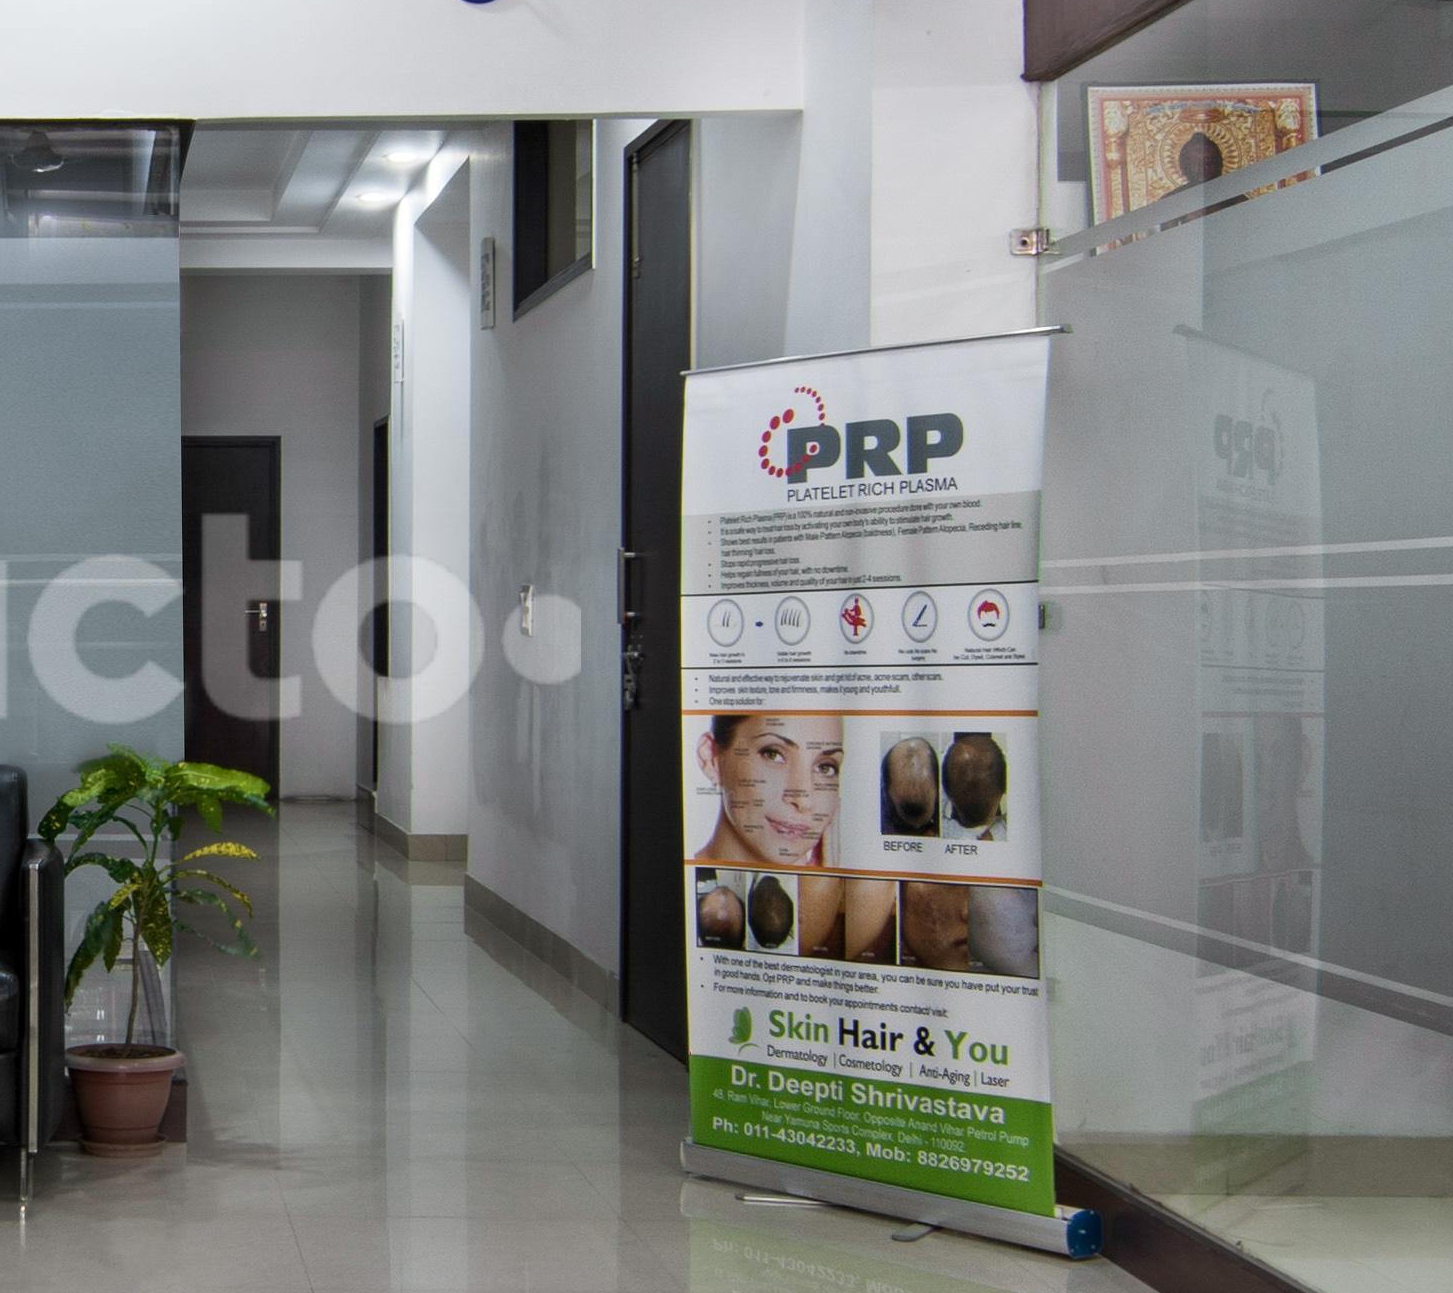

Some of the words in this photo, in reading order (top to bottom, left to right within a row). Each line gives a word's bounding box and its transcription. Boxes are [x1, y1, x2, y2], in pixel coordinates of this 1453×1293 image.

[786, 412, 964, 485] PRP
[788, 484, 855, 502] PLATELET
[858, 482, 895, 497] RICH
[900, 477, 958, 494] PLASMA
[969, 523, 998, 533] Receding
[883, 841, 924, 853] BEFORE
[944, 844, 978, 856] AFTER
[713, 955, 730, 965] With
[730, 958, 743, 967] one
[745, 957, 753, 968] of
[753, 958, 763, 970] the
[764, 960, 780, 971] best
[781, 962, 834, 977] dermatologist
[835, 966, 840, 976] in
[842, 968, 856, 979] your
[881, 973, 897, 984] you
[899, 974, 914, 983] can
[916, 976, 926, 985] be
[927, 978, 944, 987] sure
[945, 980, 960, 989] you
[962, 980, 984, 991] have
[985, 982, 1000, 994] put
[1001, 985, 1020, 996] your
[1022, 987, 1039, 996] trust
[714, 968, 721, 976] in
[722, 970, 738, 979] good
[763, 973, 776, 984] Opt
[777, 974, 795, 983] PRP
[796, 977, 810, 987] and
[812, 979, 832, 989] make
[833, 981, 854, 994] things
[713, 982, 726, 991] For
[727, 985, 744, 995] more
[745, 986, 784, 1000] information
[785, 992, 800, 1002] and
[801, 993, 808, 1002] to
[809, 994, 828, 1004] book
[829, 997, 844, 1006] your
[845, 998, 898, 1013] appointments
[769, 1009, 830, 1044] Skin
[839, 1017, 904, 1051] Hair
[914, 1026, 935, 1058] &
[944, 1030, 1010, 1066] You
[767, 1045, 828, 1067] Dermatology
[839, 1054, 904, 1077] Cosmetology
[919, 1063, 970, 1086] Anti-Aging
[982, 1073, 1010, 1088] Laser
[731, 1064, 761, 1089] Dr.
[768, 1070, 843, 1103] Deepti
[851, 1082, 1005, 1124] Shrivastava
[728, 1090, 748, 1103] Ram
[773, 1098, 802, 1112] Lower
[803, 1102, 836, 1117] Ground
[863, 1112, 906, 1128] Opposite
[908, 1118, 938, 1132] Anand
[939, 1122, 964, 1136] Vihar
[967, 1126, 996, 1140] Petrol
[999, 1131, 1029, 1146] Pump
[762, 1110, 783, 1123] Near
[784, 1113, 820, 1130] Yamuna
[822, 1120, 850, 1134] Sports
[898, 1132, 923, 1146] Delhi
[932, 1138, 965, 1153] 110092
[712, 1116, 739, 1134] Ph:
[744, 1122, 861, 1156] 011-43042233,
[866, 1142, 911, 1163] Mob:
[917, 1150, 1030, 1182] 8826979252
